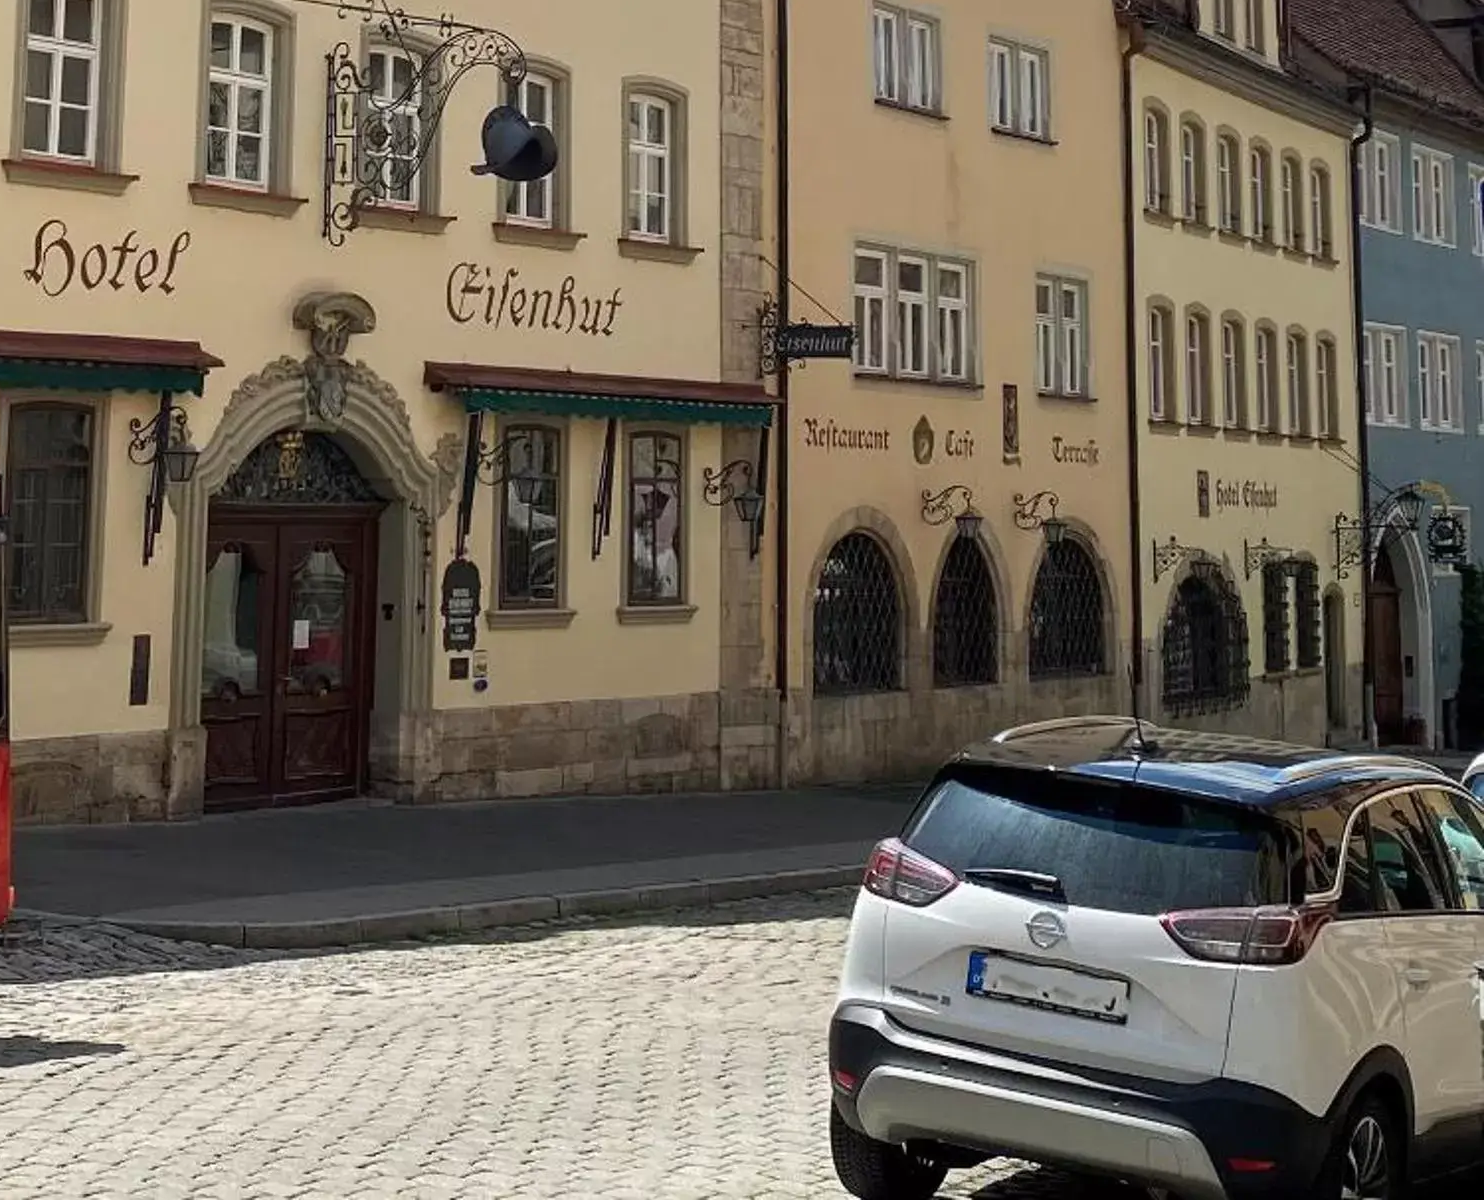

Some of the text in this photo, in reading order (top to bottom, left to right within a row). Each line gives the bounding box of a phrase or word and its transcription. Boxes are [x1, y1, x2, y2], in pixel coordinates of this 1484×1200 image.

[23, 219, 191, 297] Hotel
[777, 332, 848, 352] Eisenhut
[804, 418, 890, 453] Restaurant
